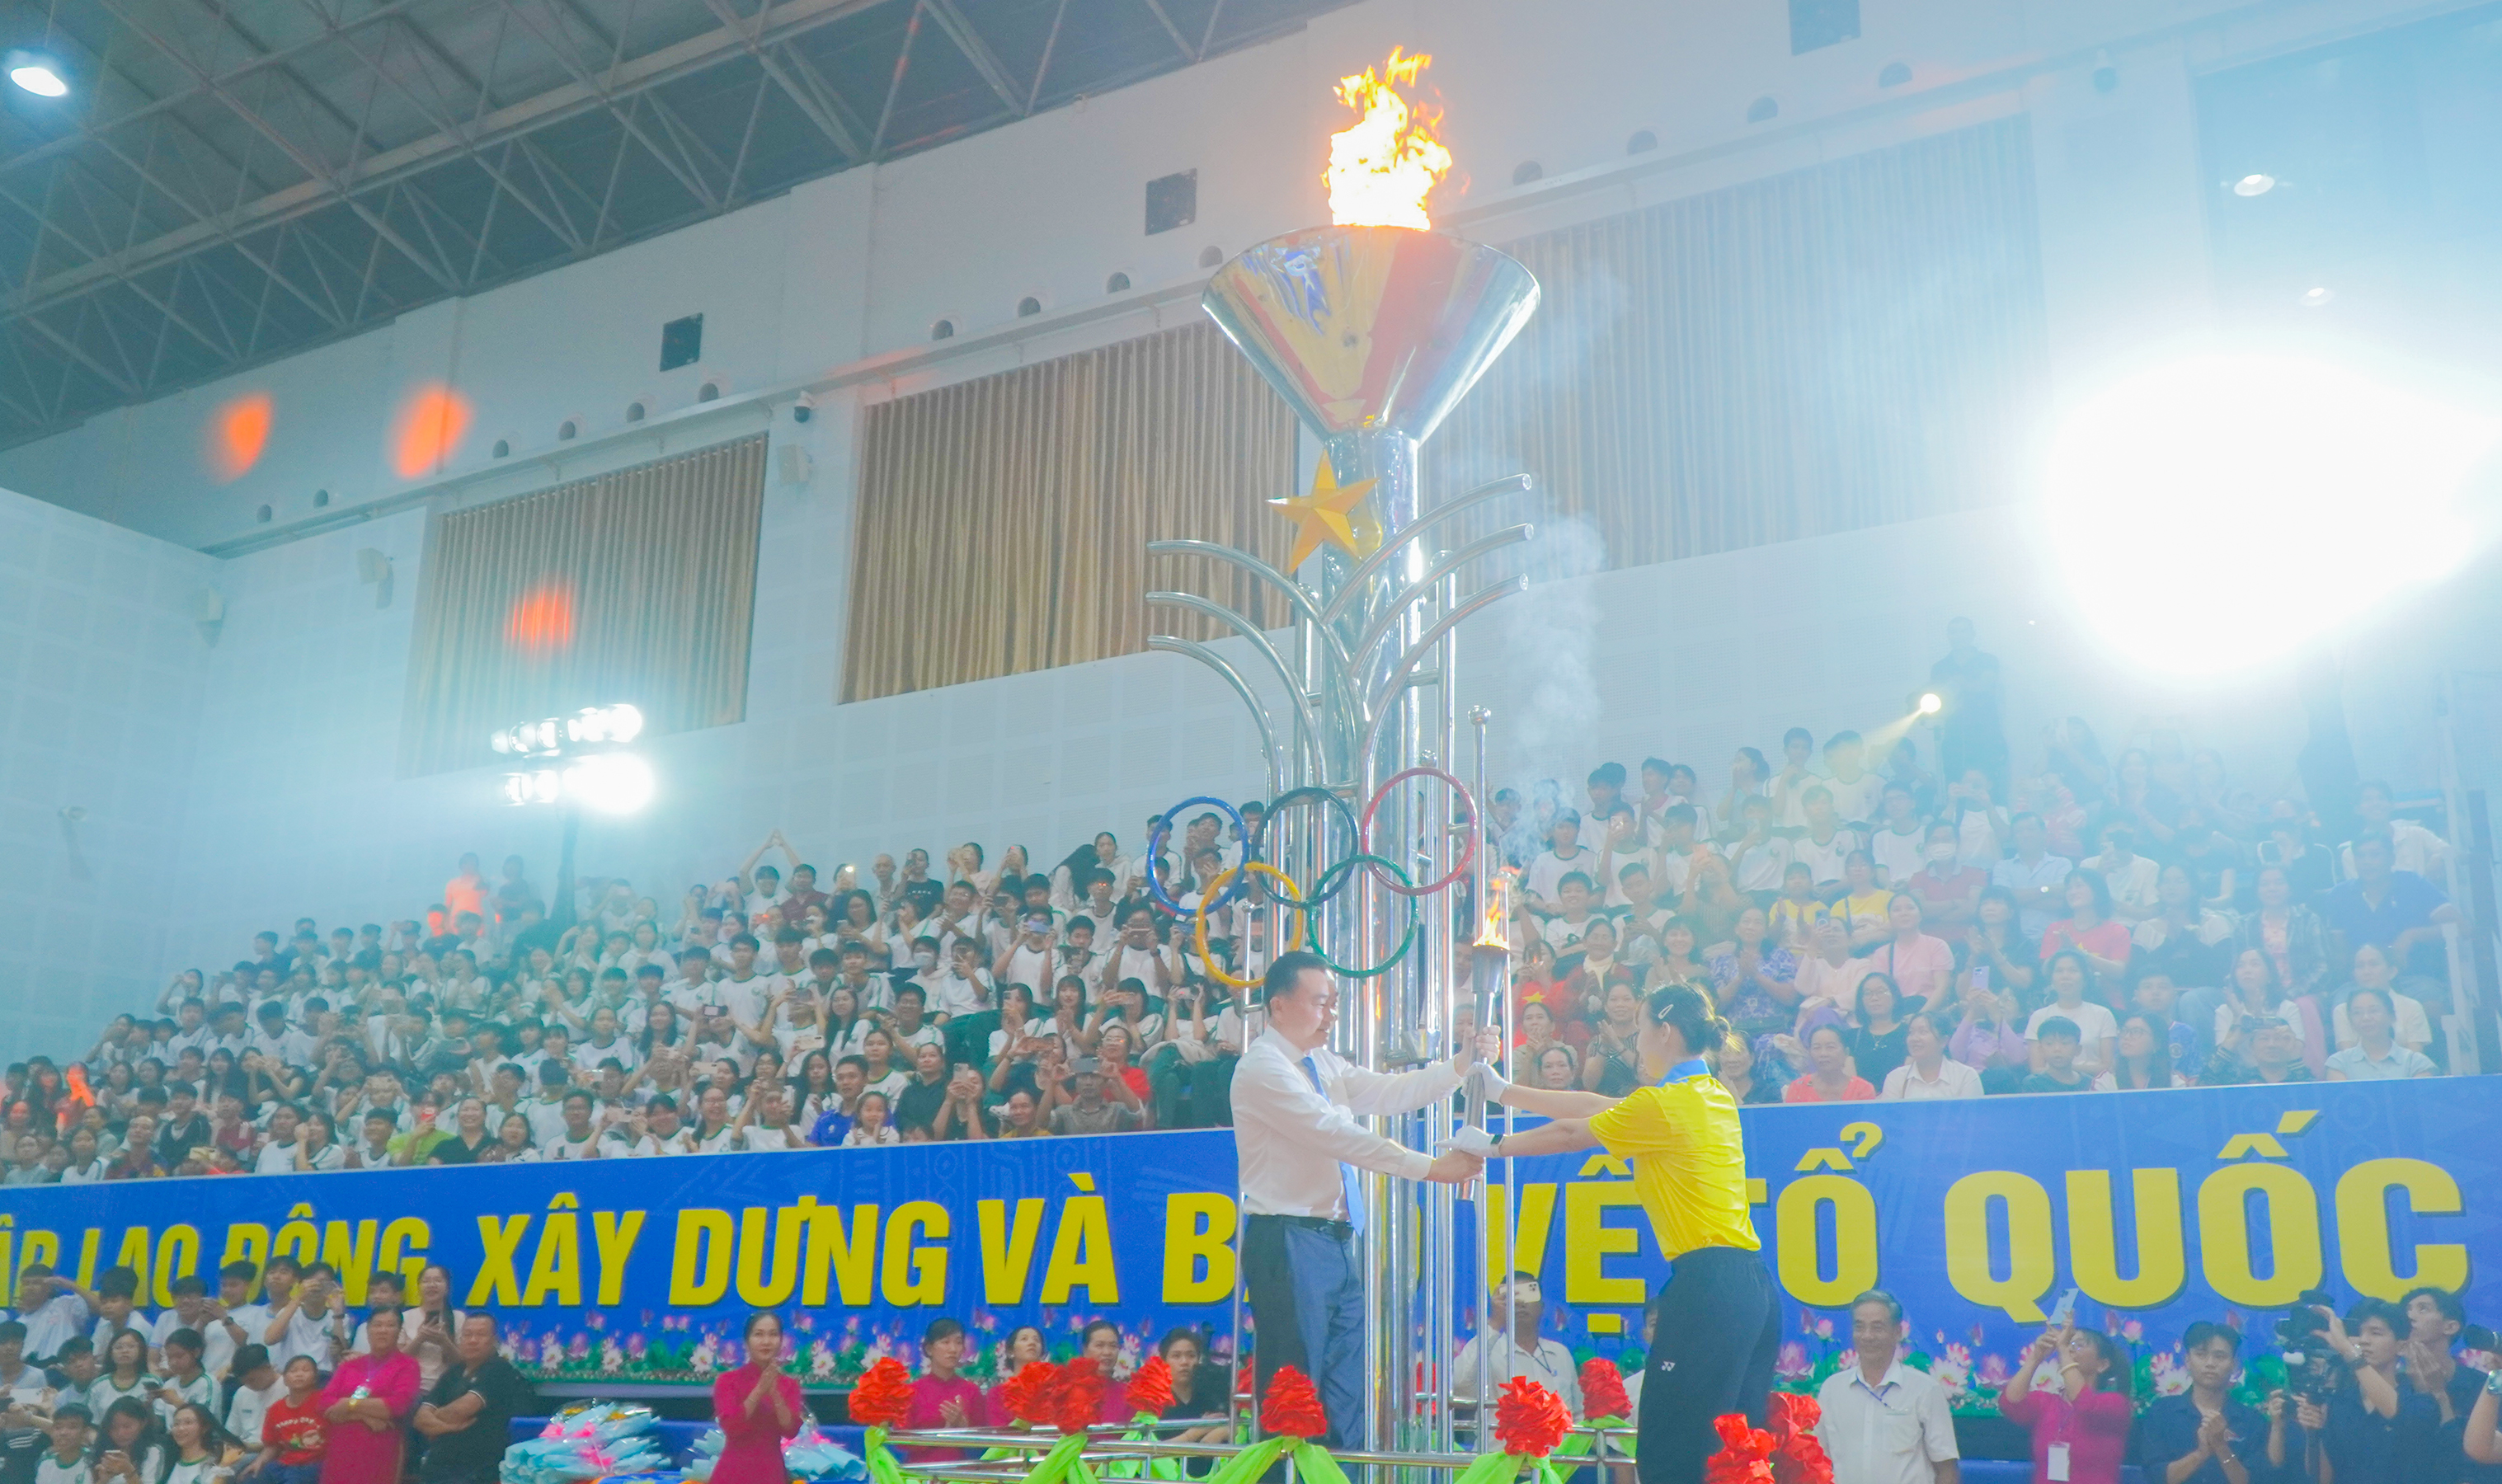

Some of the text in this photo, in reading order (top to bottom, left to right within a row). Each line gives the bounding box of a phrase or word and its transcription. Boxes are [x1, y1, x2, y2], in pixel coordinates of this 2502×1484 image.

[467, 1192, 647, 1307] XÂY
[977, 1172, 1119, 1305] VÀ
[1944, 1110, 2468, 1323] QUỐC
